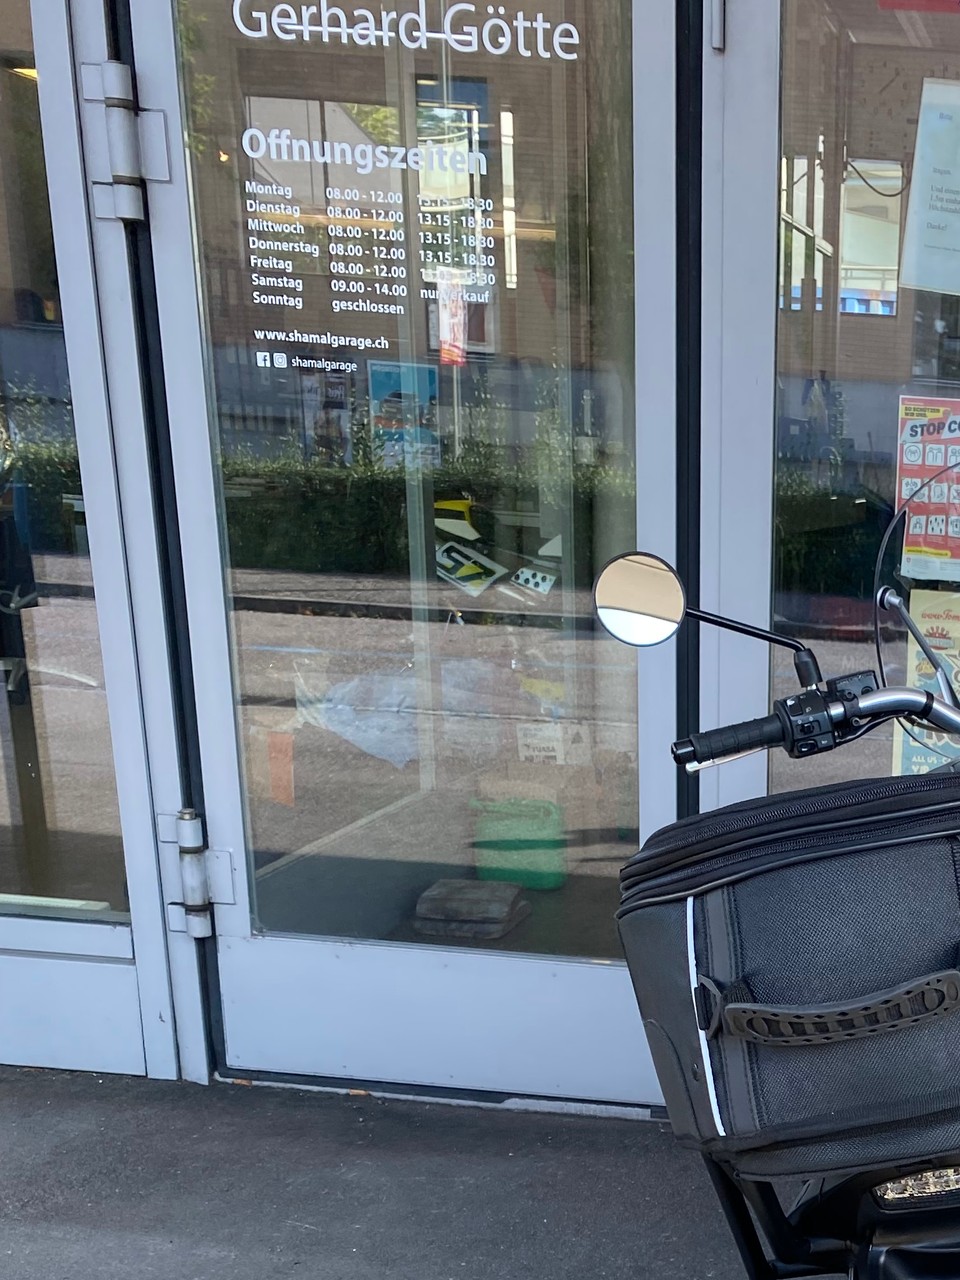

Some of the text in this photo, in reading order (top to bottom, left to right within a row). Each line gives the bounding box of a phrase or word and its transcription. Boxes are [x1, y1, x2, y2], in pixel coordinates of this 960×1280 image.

[233, 0, 580, 60] Gerhard Götte
[245, 181, 292, 199] Montag
[326, 187, 359, 200] 08.00
[370, 191, 403, 204] 12.00
[246, 200, 300, 217] Dienstag
[327, 206, 360, 219] 08.00
[371, 209, 404, 223] 12.00
[417, 213, 450, 226] 13.15
[460, 216, 494, 230] 1830
[247, 219, 305, 235] Mittwoch
[328, 225, 361, 238] 08.00
[371, 228, 405, 241] 12.00
[418, 231, 451, 245] 13.15
[461, 235, 495, 249] 1830
[249, 237, 320, 257] Donnerstag
[329, 243, 362, 257] 08.00
[373, 246, 406, 260] 12.00
[419, 250, 451, 263] 13.15
[462, 253, 496, 267] 18.30
[250, 255, 293, 272] Freitag
[330, 261, 364, 275] 08.00
[373, 265, 407, 278] 12.00
[251, 274, 303, 292] Samstag
[331, 280, 364, 293] 09.00
[374, 283, 407, 297] 14.00
[252, 291, 405, 315] Sonntag geschlossen
[254, 329, 389, 350] www.shamalgarage.ch
[291, 353, 358, 372] shamalgarage
[909, 422, 946, 438] STOP
